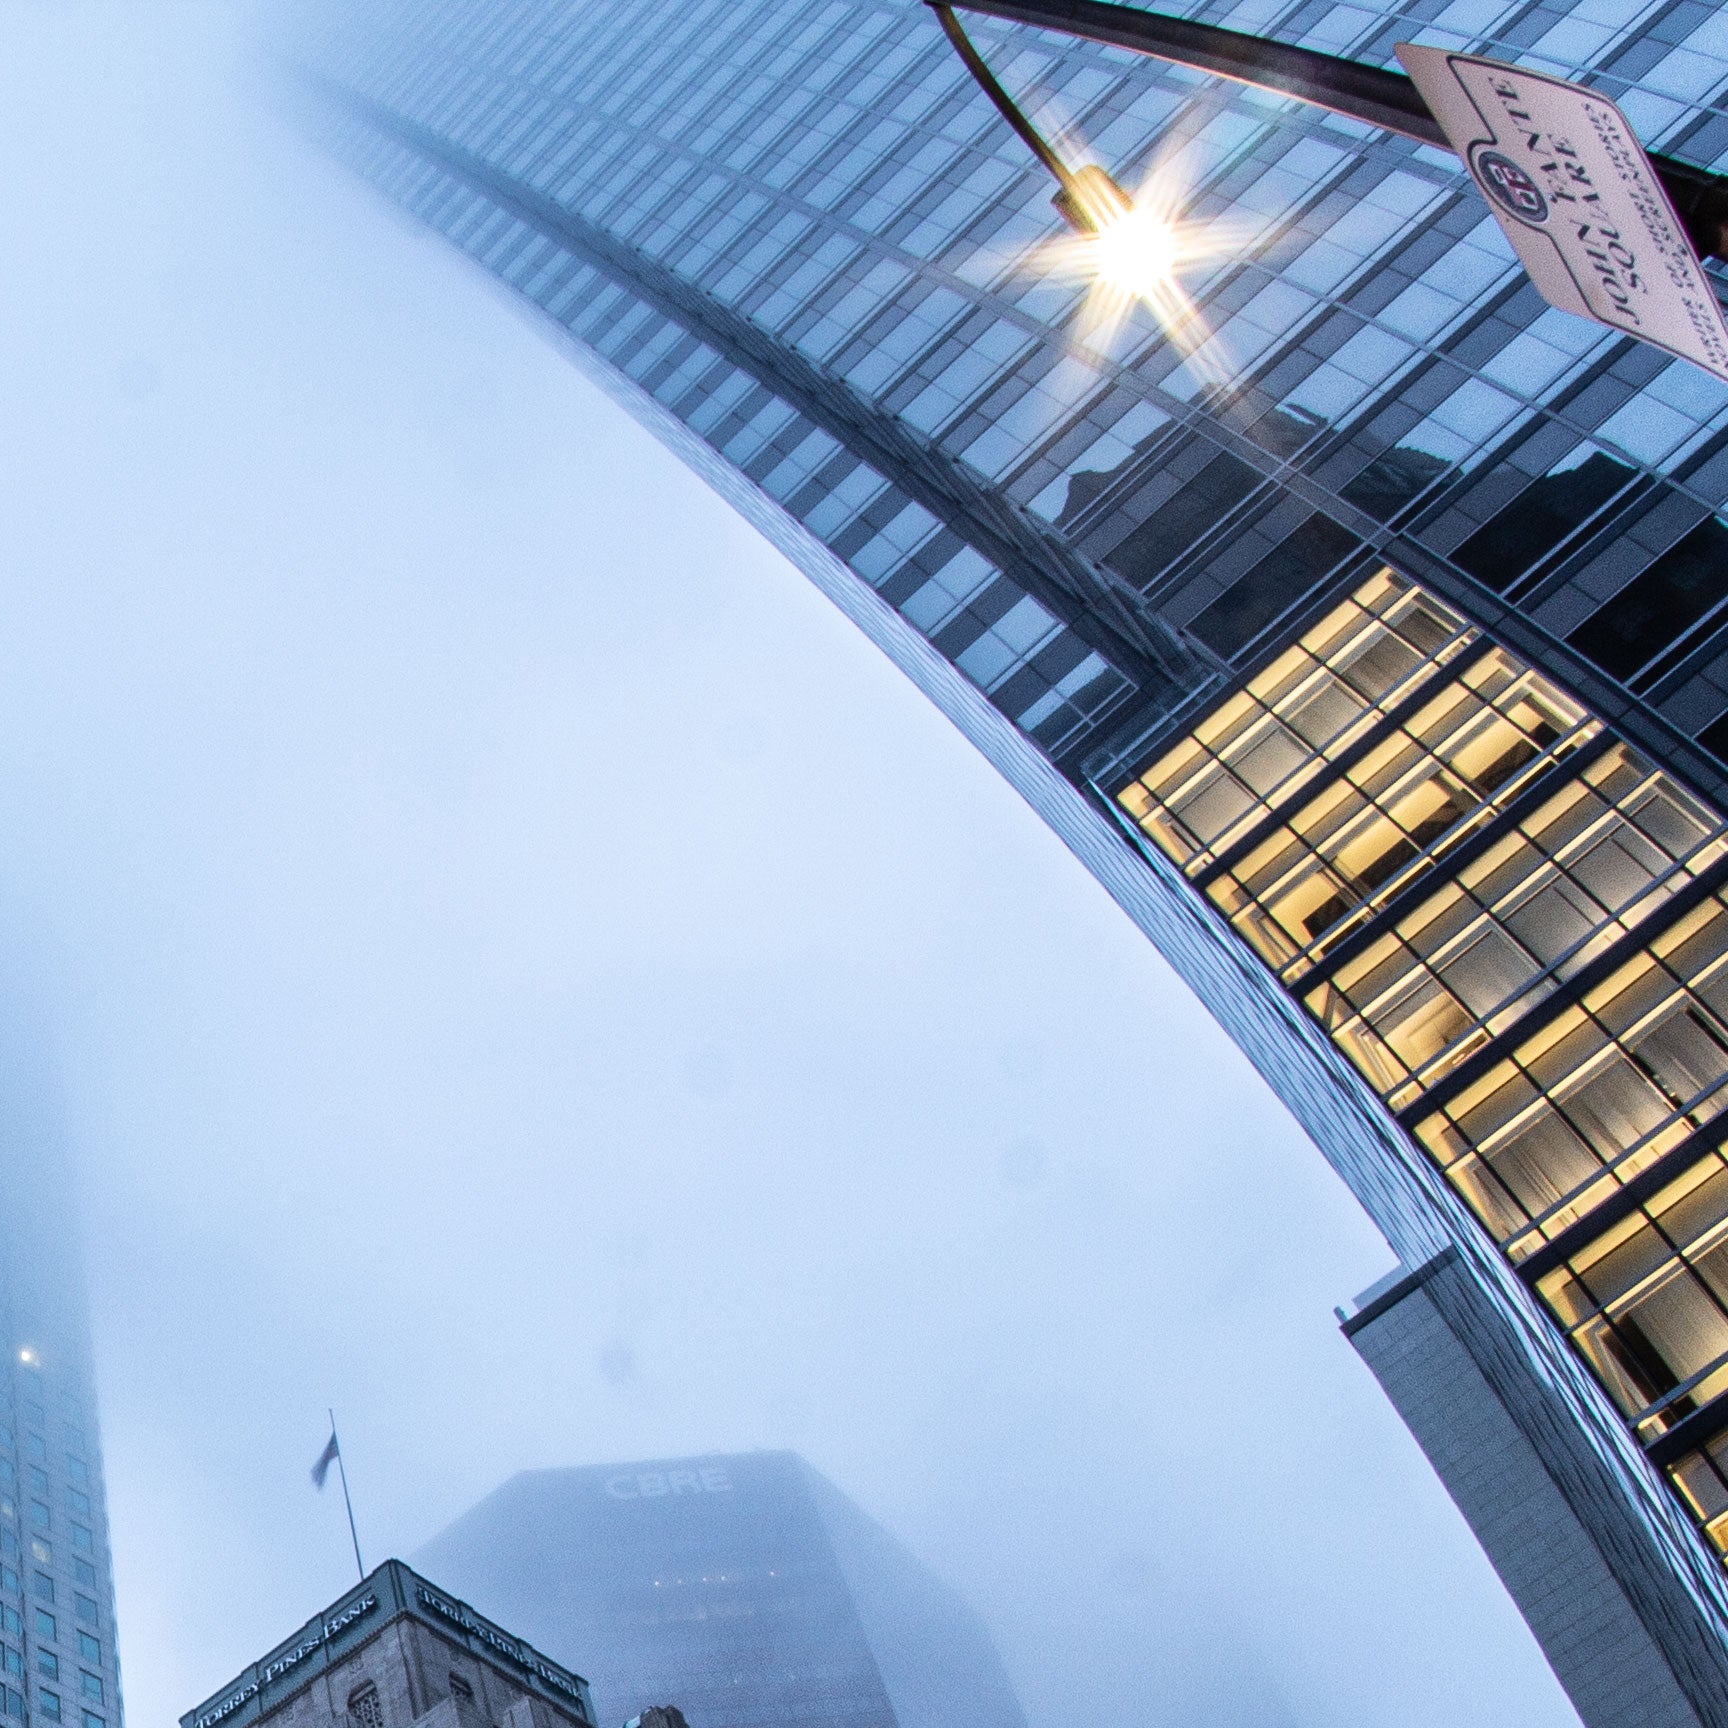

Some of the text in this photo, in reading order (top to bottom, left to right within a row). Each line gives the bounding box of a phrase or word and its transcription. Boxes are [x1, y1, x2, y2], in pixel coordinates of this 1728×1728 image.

[1487, 76, 1640, 326] JOHN FANTE
[1546, 134, 1649, 295] SQUARE
[1694, 301, 1728, 369] OVELS
[605, 1467, 735, 1499] CBRE
[265, 1637, 321, 1682] PINES
[322, 1594, 377, 1640] BANK
